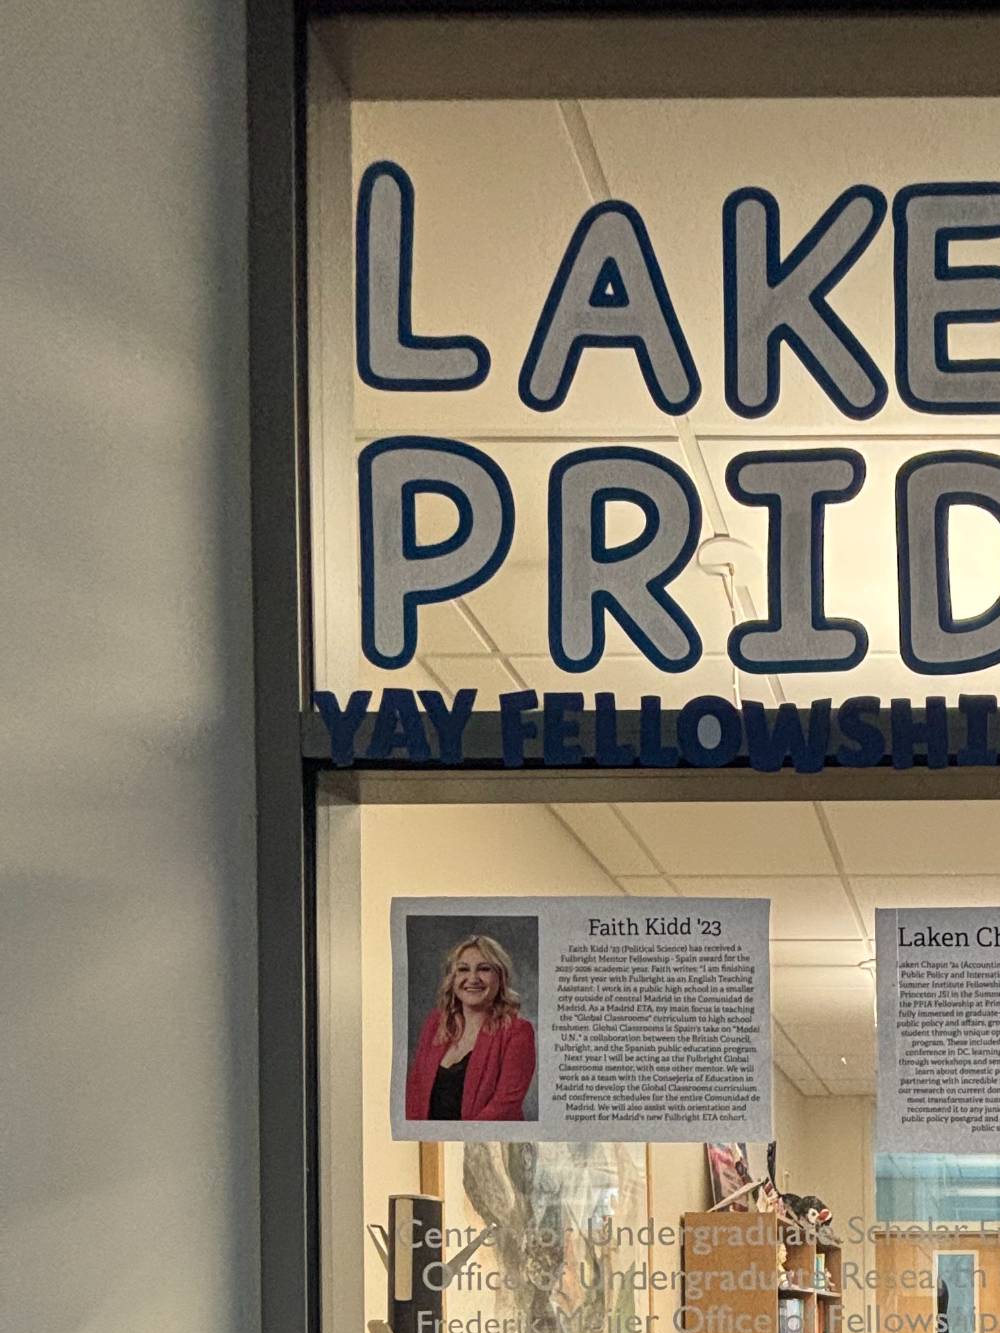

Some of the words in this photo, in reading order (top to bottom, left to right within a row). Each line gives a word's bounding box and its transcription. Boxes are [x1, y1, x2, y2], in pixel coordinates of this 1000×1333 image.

[314, 688, 478, 767] YAY
[588, 917, 640, 937] Faith
[645, 917, 693, 936] Kidd
[696, 917, 723, 937] '23
[898, 926, 970, 947] Laken
